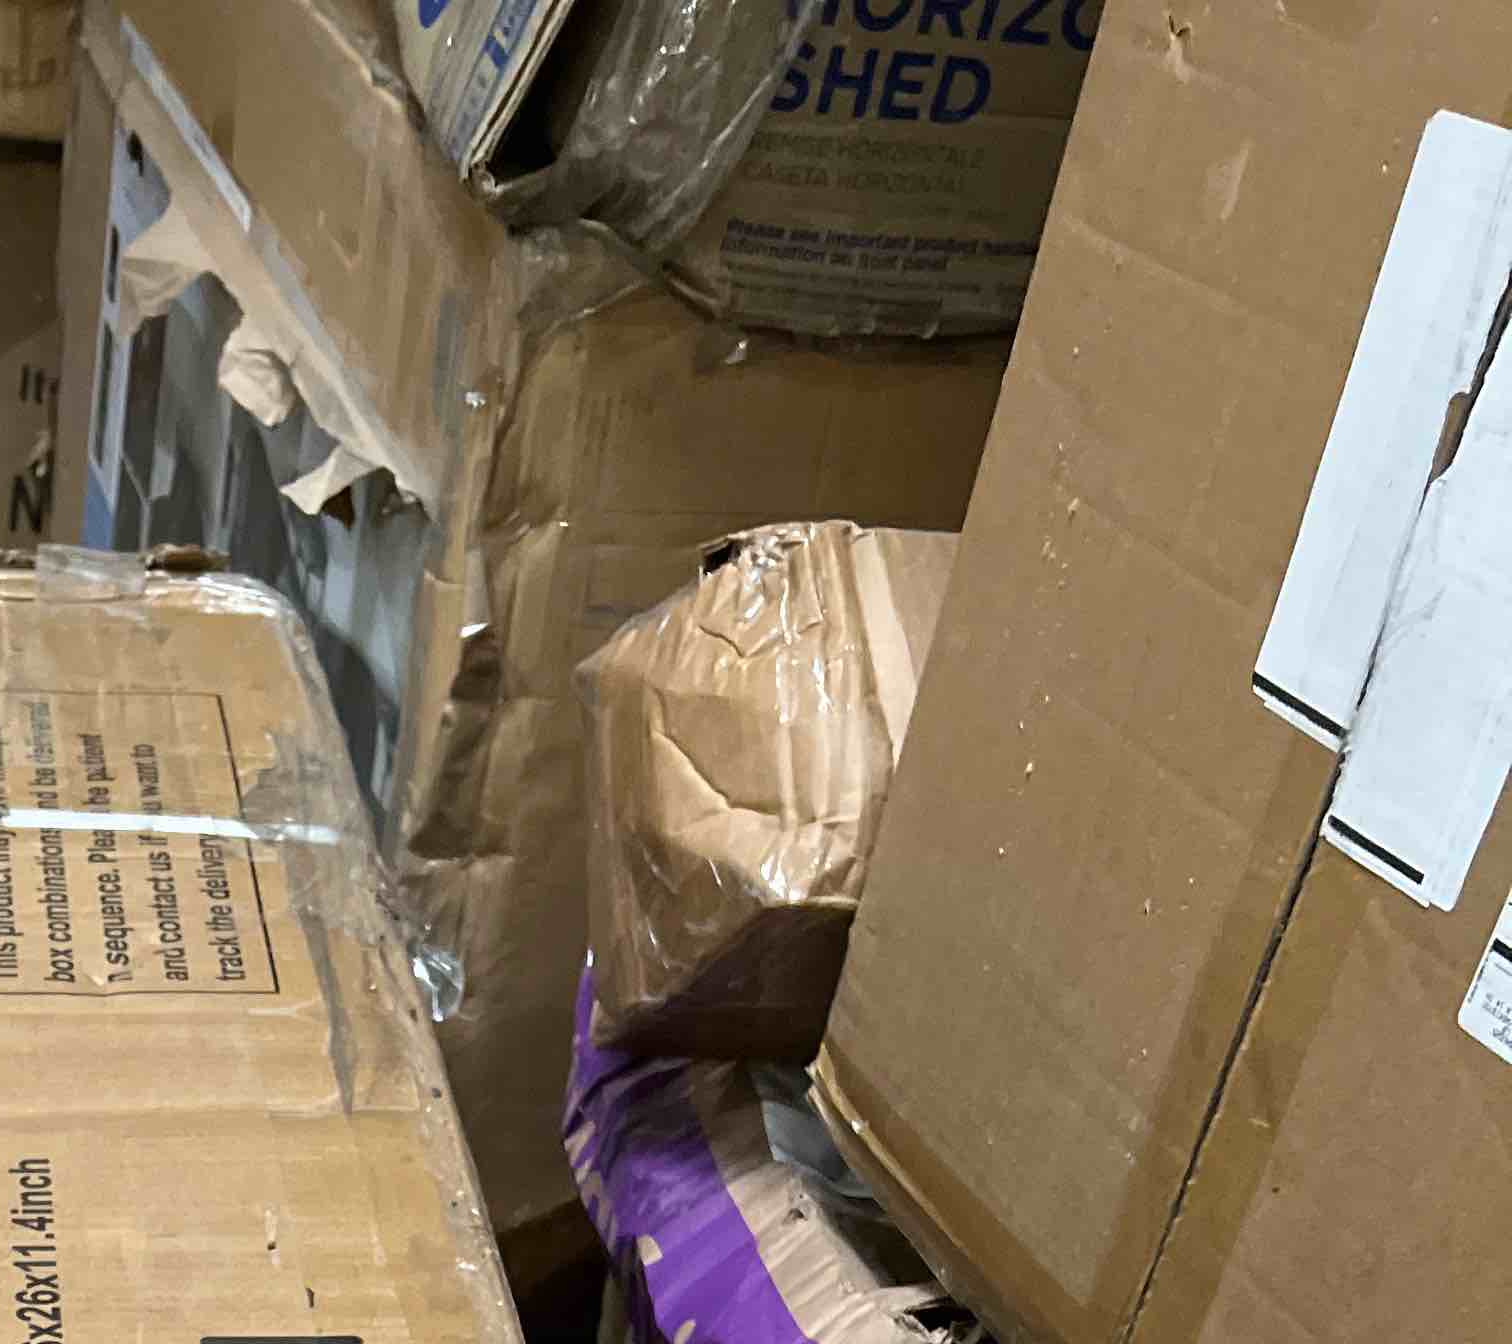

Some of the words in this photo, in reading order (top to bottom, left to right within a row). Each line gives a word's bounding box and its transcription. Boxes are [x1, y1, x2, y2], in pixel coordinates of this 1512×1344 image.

[770, 41, 991, 124] SHED
[85, 809, 117, 864] Plea
[138, 834, 168, 848] if
[148, 851, 172, 872] us
[35, 828, 72, 943] combinations
[195, 833, 230, 901] delivery
[96, 867, 133, 968] sequence.
[149, 876, 183, 943] contact
[203, 904, 234, 932] the
[42, 948, 77, 983] box
[154, 945, 189, 982] and
[208, 935, 245, 982] track
